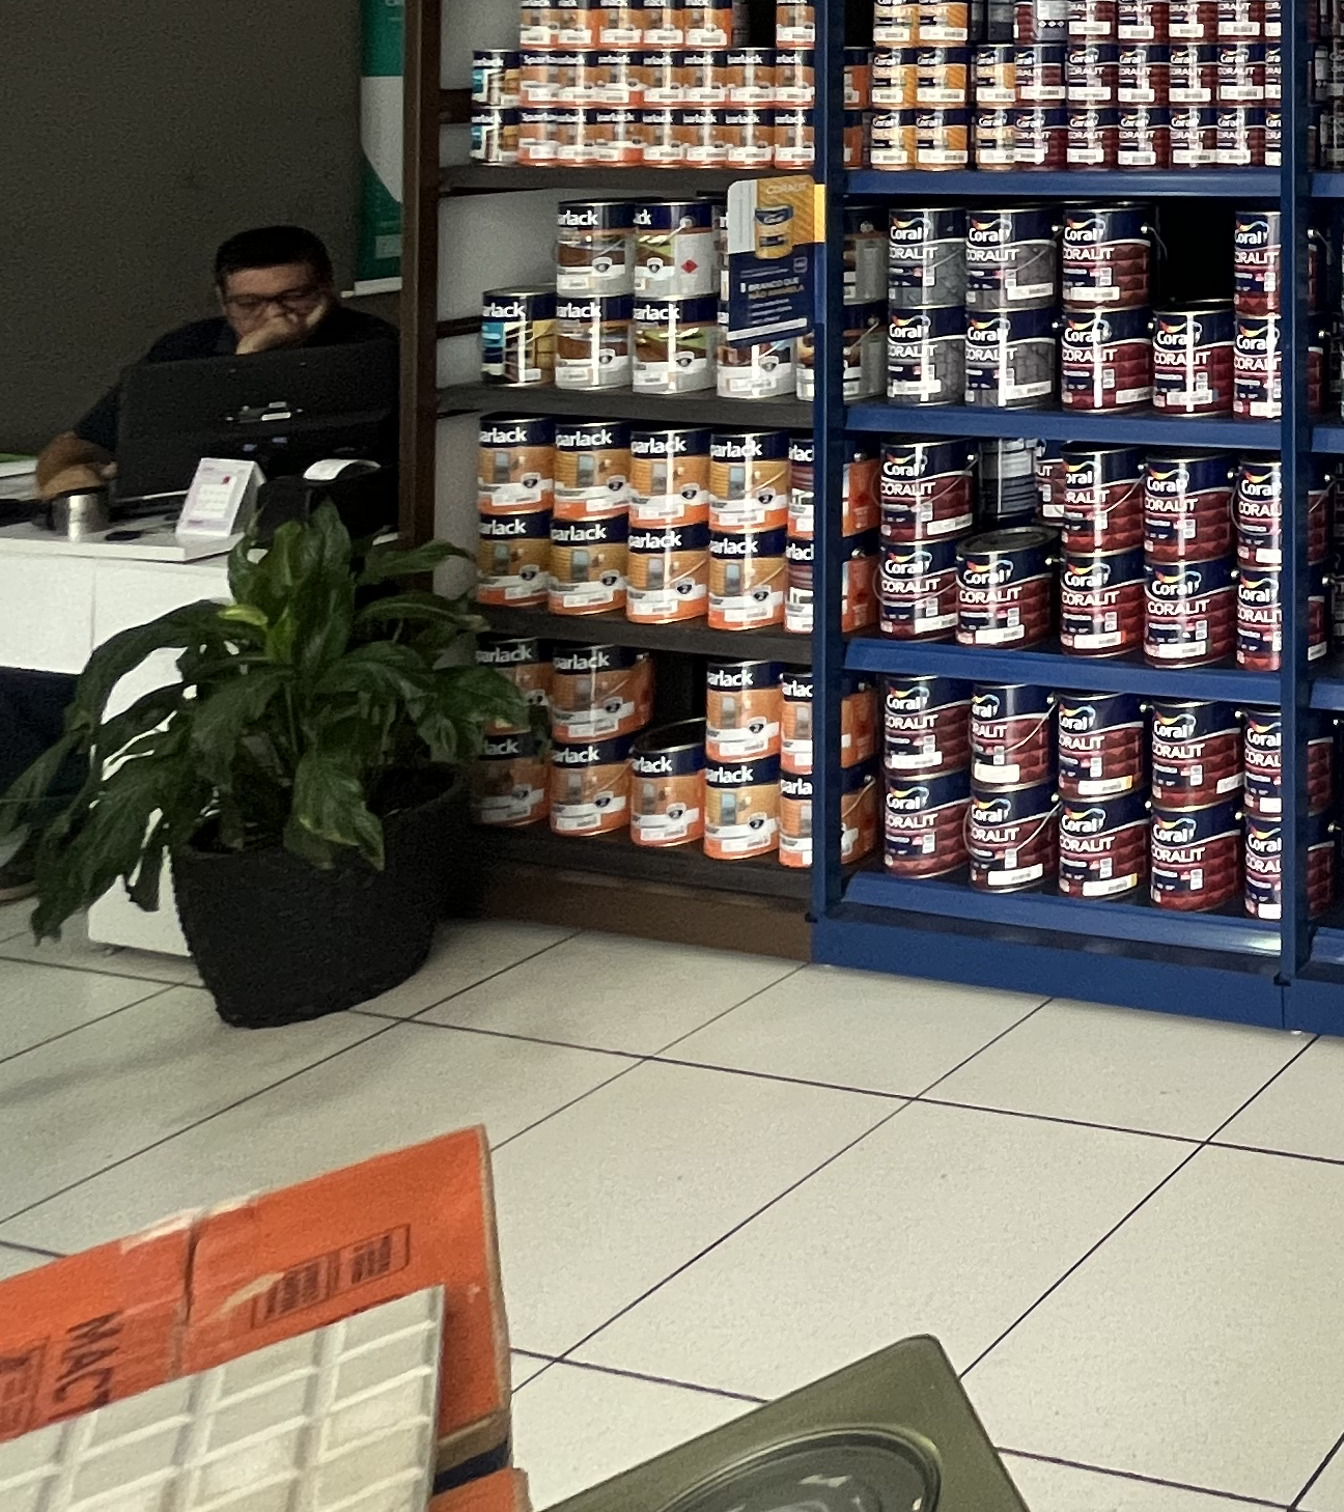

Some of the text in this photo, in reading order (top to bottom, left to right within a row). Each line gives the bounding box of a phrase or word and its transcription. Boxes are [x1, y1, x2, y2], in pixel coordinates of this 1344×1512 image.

[555, 430, 612, 446] parlack
[885, 560, 923, 574] Coral
[963, 571, 1005, 584] Coral
[882, 579, 941, 592] CORALIT
[1152, 580, 1193, 594] Coral
[960, 588, 1021, 602] CORALIT
[1148, 600, 1209, 616] CORALIT
[1153, 825, 1189, 841] Coral
[48, 1310, 125, 1420] MACT
